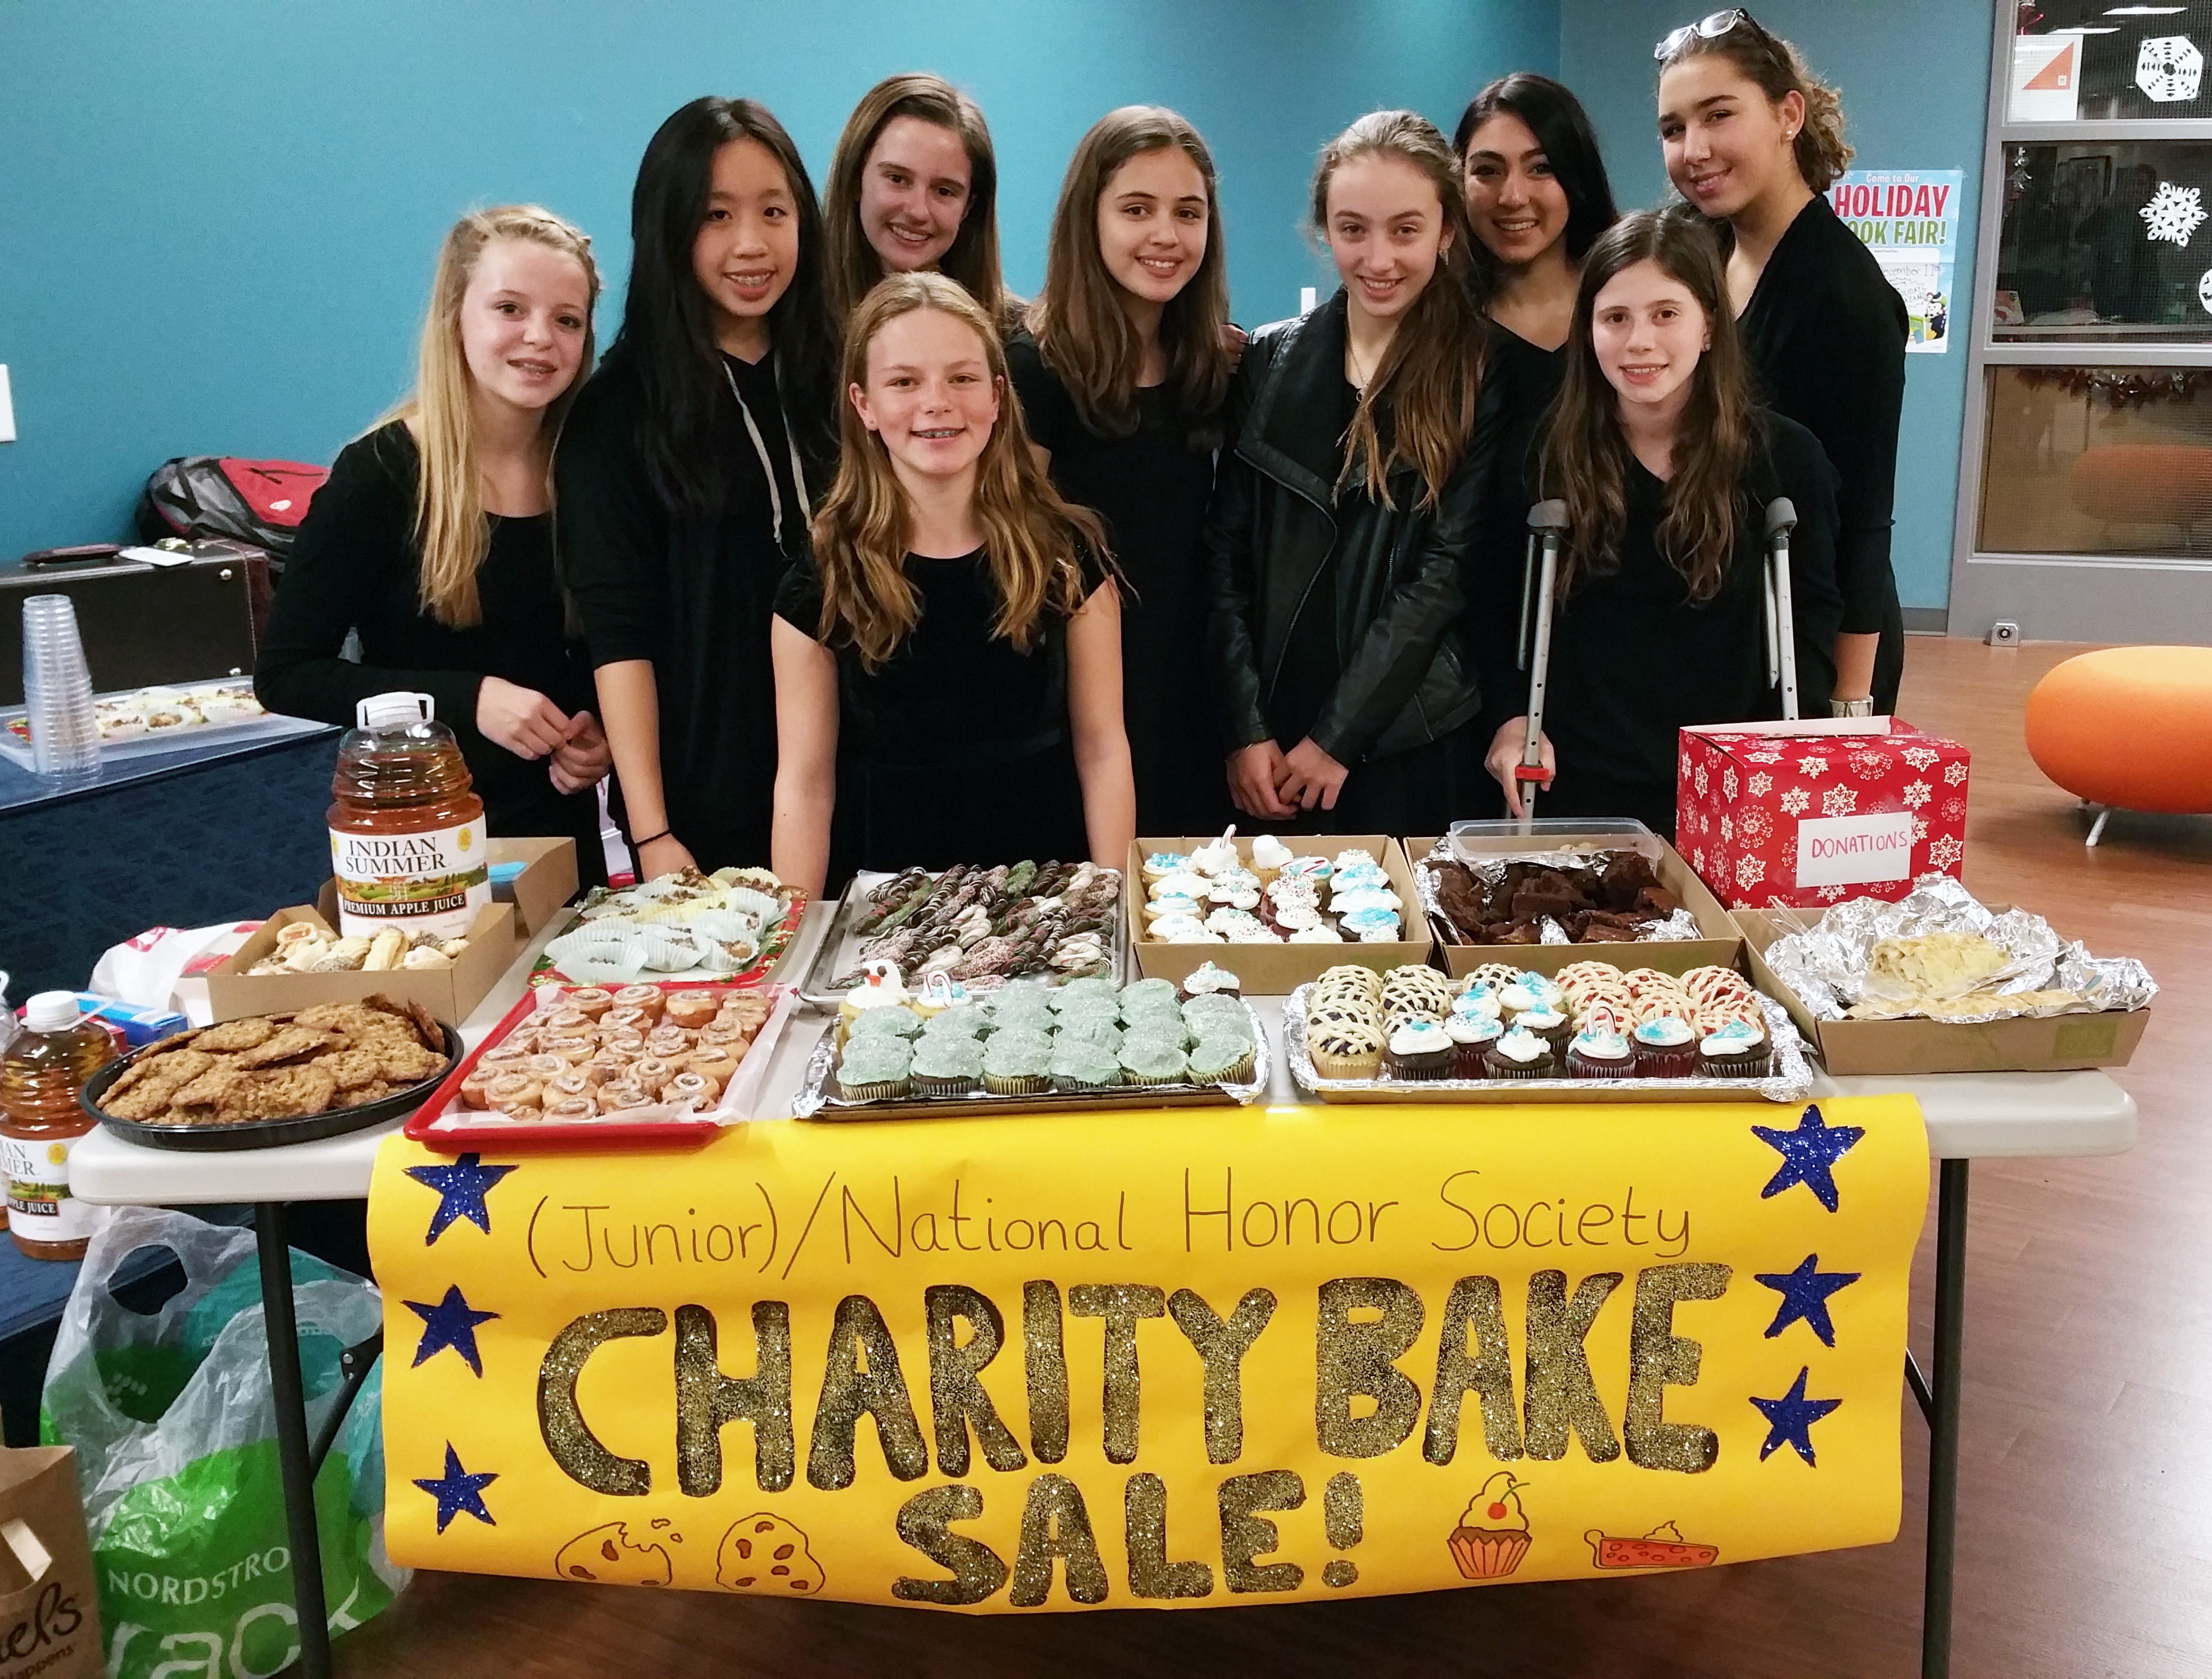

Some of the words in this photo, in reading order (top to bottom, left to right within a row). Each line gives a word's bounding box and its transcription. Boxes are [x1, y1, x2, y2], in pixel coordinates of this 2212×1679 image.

[1866, 173, 1889, 183] Come
[1892, 174, 1901, 183] to
[1904, 174, 1919, 183] Our
[1834, 185, 1950, 217] HOLIDAY
[1847, 220, 1888, 244] OK
[1893, 220, 1947, 244] FAIR!
[349, 837, 437, 857] INDIAN
[1811, 831, 1908, 859] DONATIONS
[346, 853, 447, 874] SUMMER
[344, 900, 386, 915] PREMIUM
[391, 900, 429, 914] APPLE
[433, 894, 464, 913] JUICE
[28, 1202, 56, 1214] JUICE
[1184, 1167, 1399, 1252] Honor
[1432, 1170, 1690, 1256] Society
[537, 1280, 1277, 1497] CHARITY
[1315, 1262, 1734, 1474] BAKE
[891, 1471, 1364, 1607] SALE!
[108, 1546, 291, 1605] NORDSTRO
